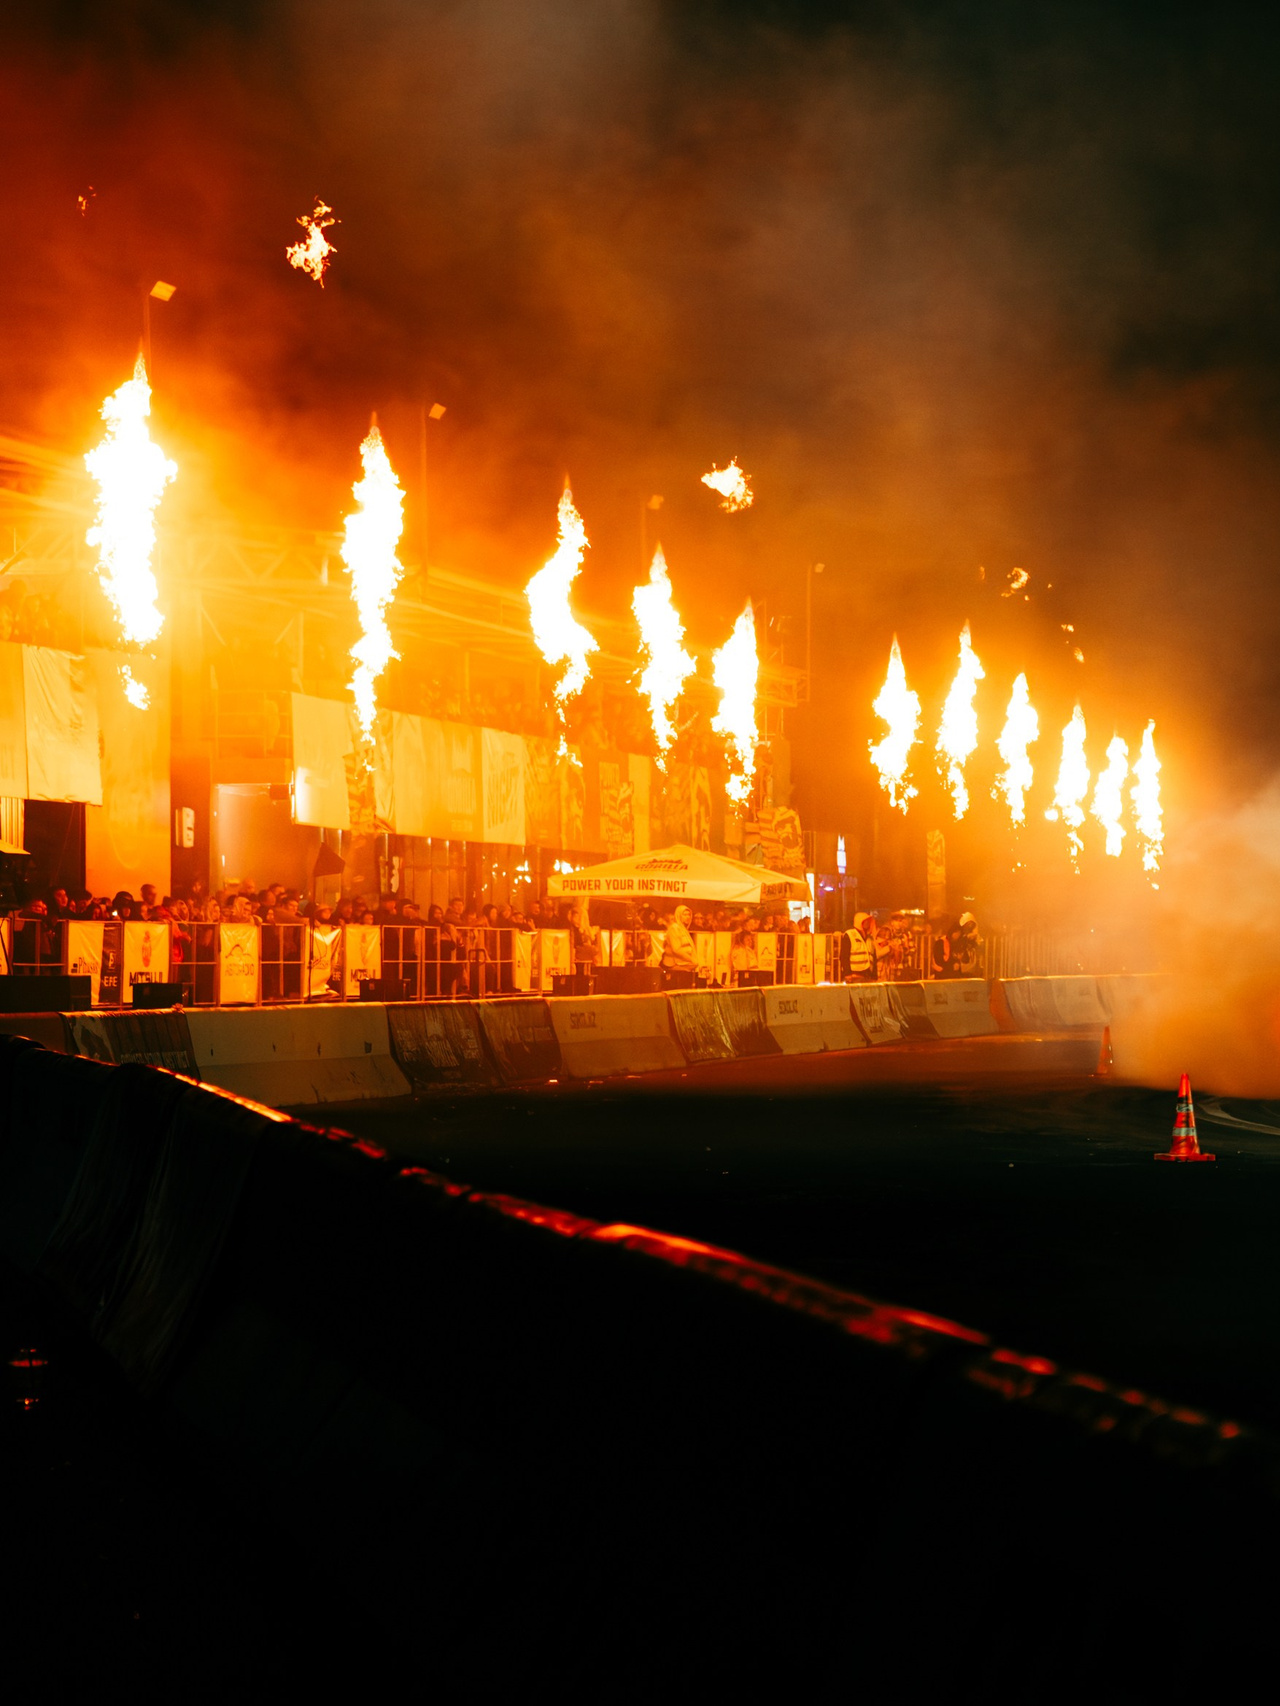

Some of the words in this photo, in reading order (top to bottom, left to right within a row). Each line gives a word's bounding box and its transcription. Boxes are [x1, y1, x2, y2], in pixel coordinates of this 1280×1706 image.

[562, 879, 601, 891] POWER
[605, 879, 634, 890] YOUR
[638, 879, 688, 892] INSTINCT
